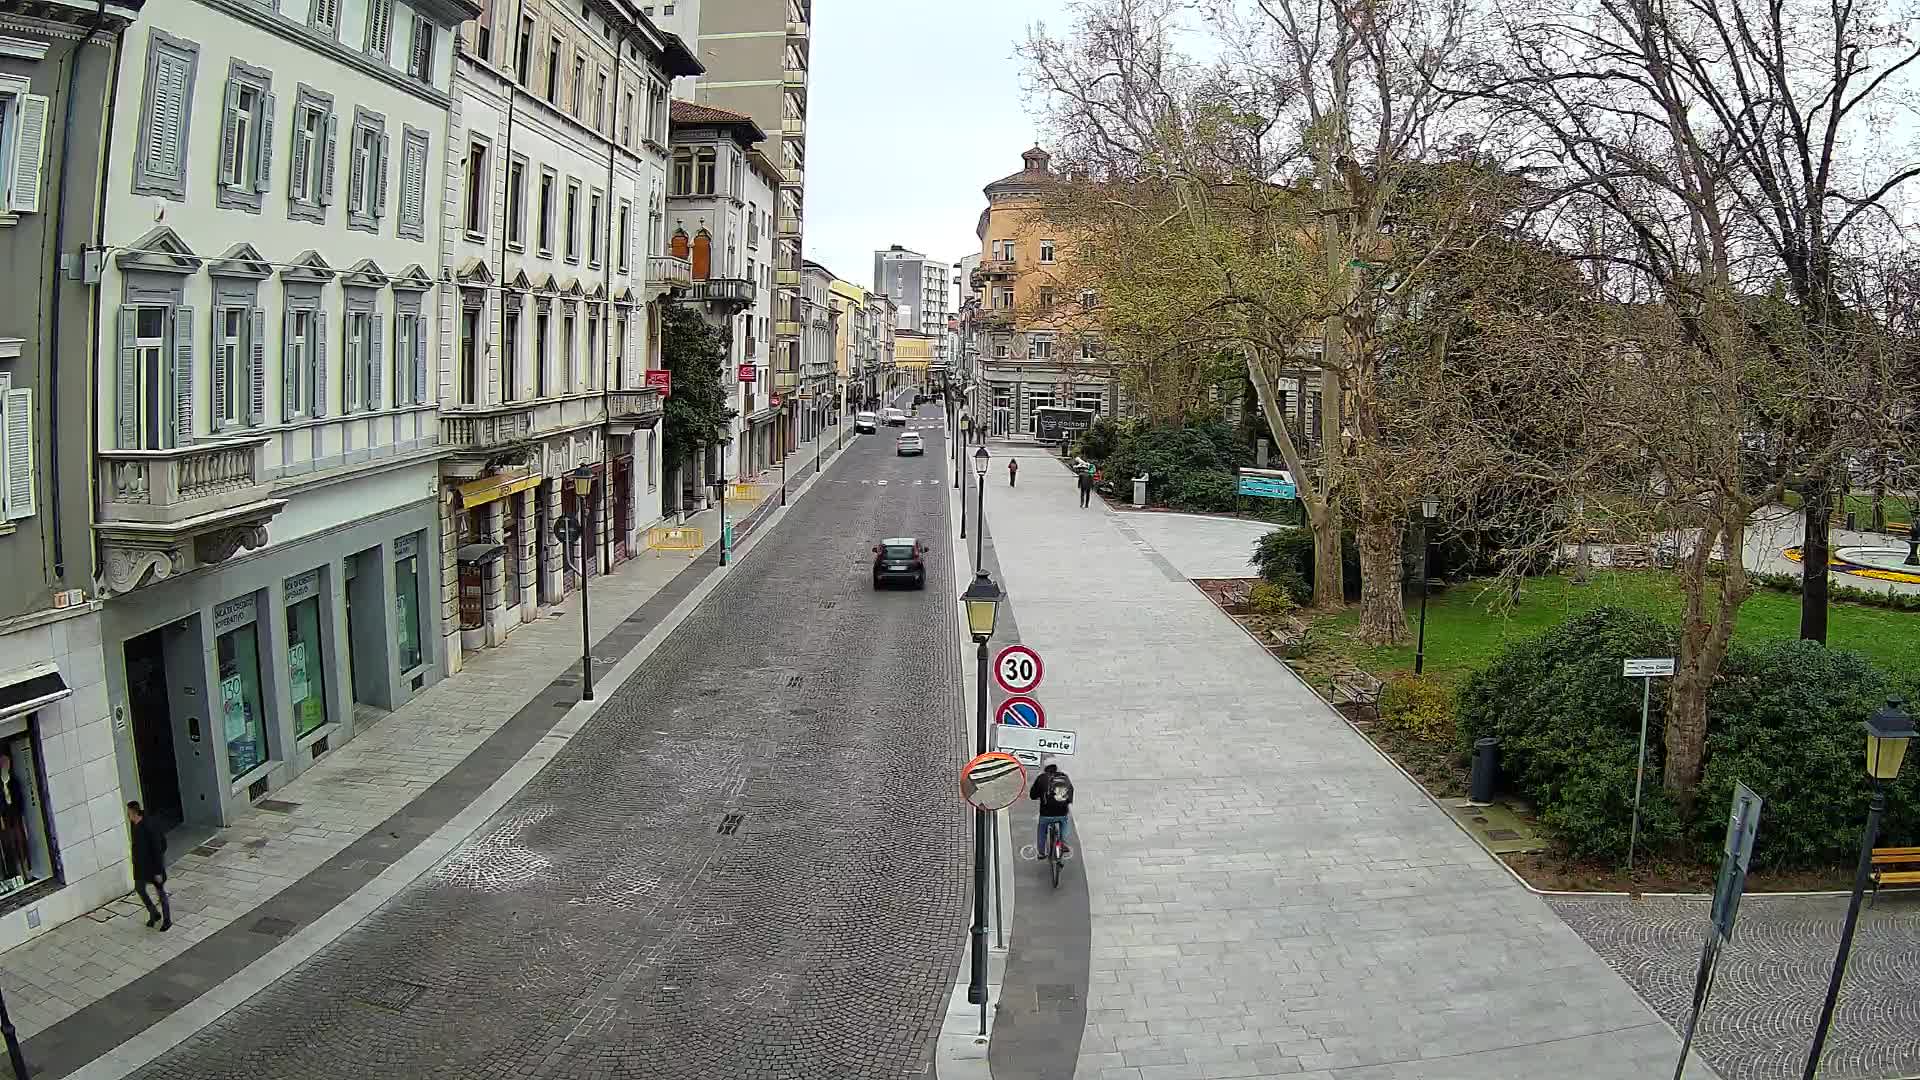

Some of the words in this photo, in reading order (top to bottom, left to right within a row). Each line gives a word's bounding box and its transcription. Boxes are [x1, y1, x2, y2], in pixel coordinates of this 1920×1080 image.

[1005, 658, 1033, 681] 30
[223, 678, 241, 702] 130
[1038, 738, 1070, 750] Dante
